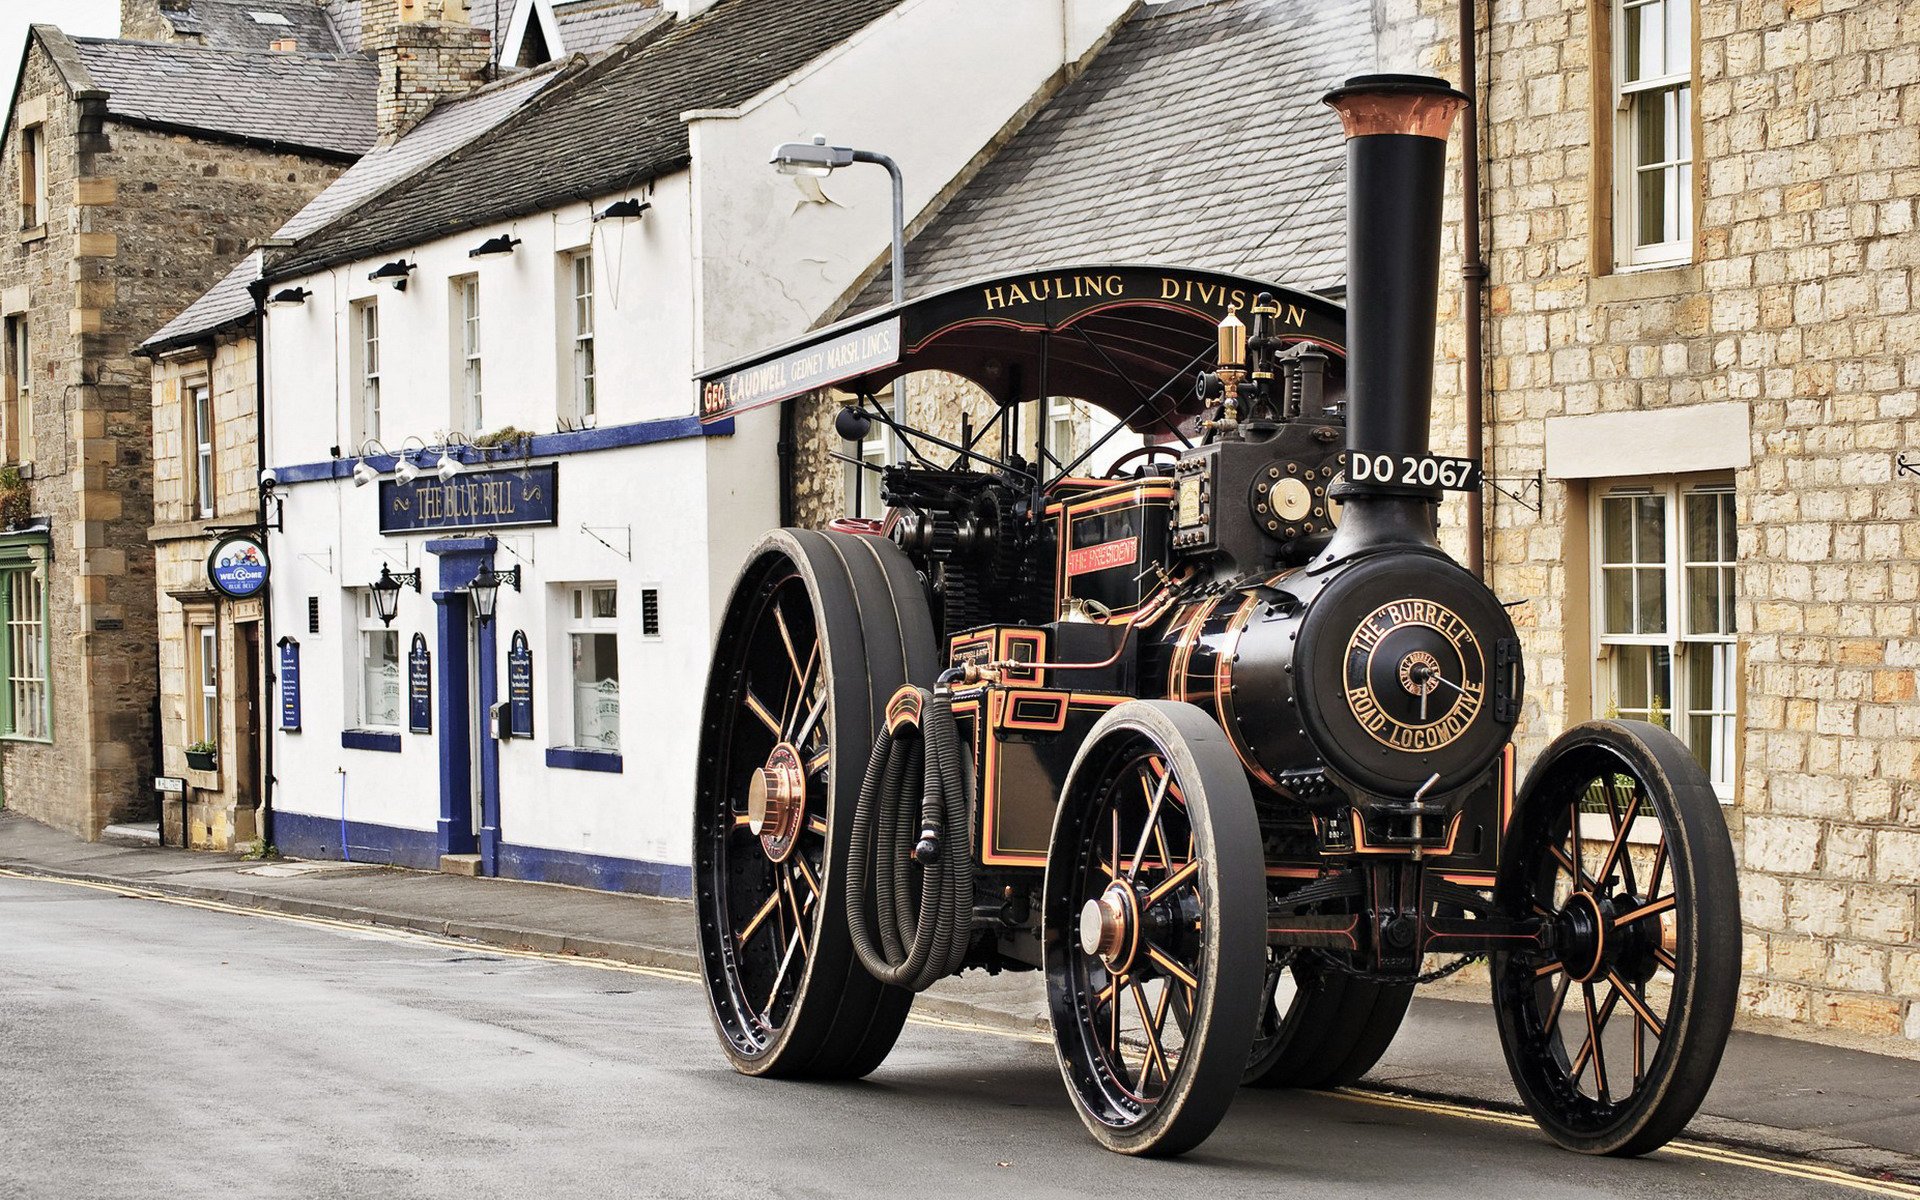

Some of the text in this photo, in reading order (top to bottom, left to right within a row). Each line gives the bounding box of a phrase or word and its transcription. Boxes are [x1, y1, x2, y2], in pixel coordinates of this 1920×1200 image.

[983, 275, 1124, 311] HAULING
[729, 362, 787, 405] CAUDWELL
[790, 351, 825, 382] GEDNEY
[1352, 452, 1472, 488] DO 2067
[415, 480, 515, 519] THE BLUE BELL
[1070, 550, 1088, 571] THE
[1351, 617, 1386, 653] THE
[1348, 680, 1482, 749] ROAD LOCOMOTIVE
